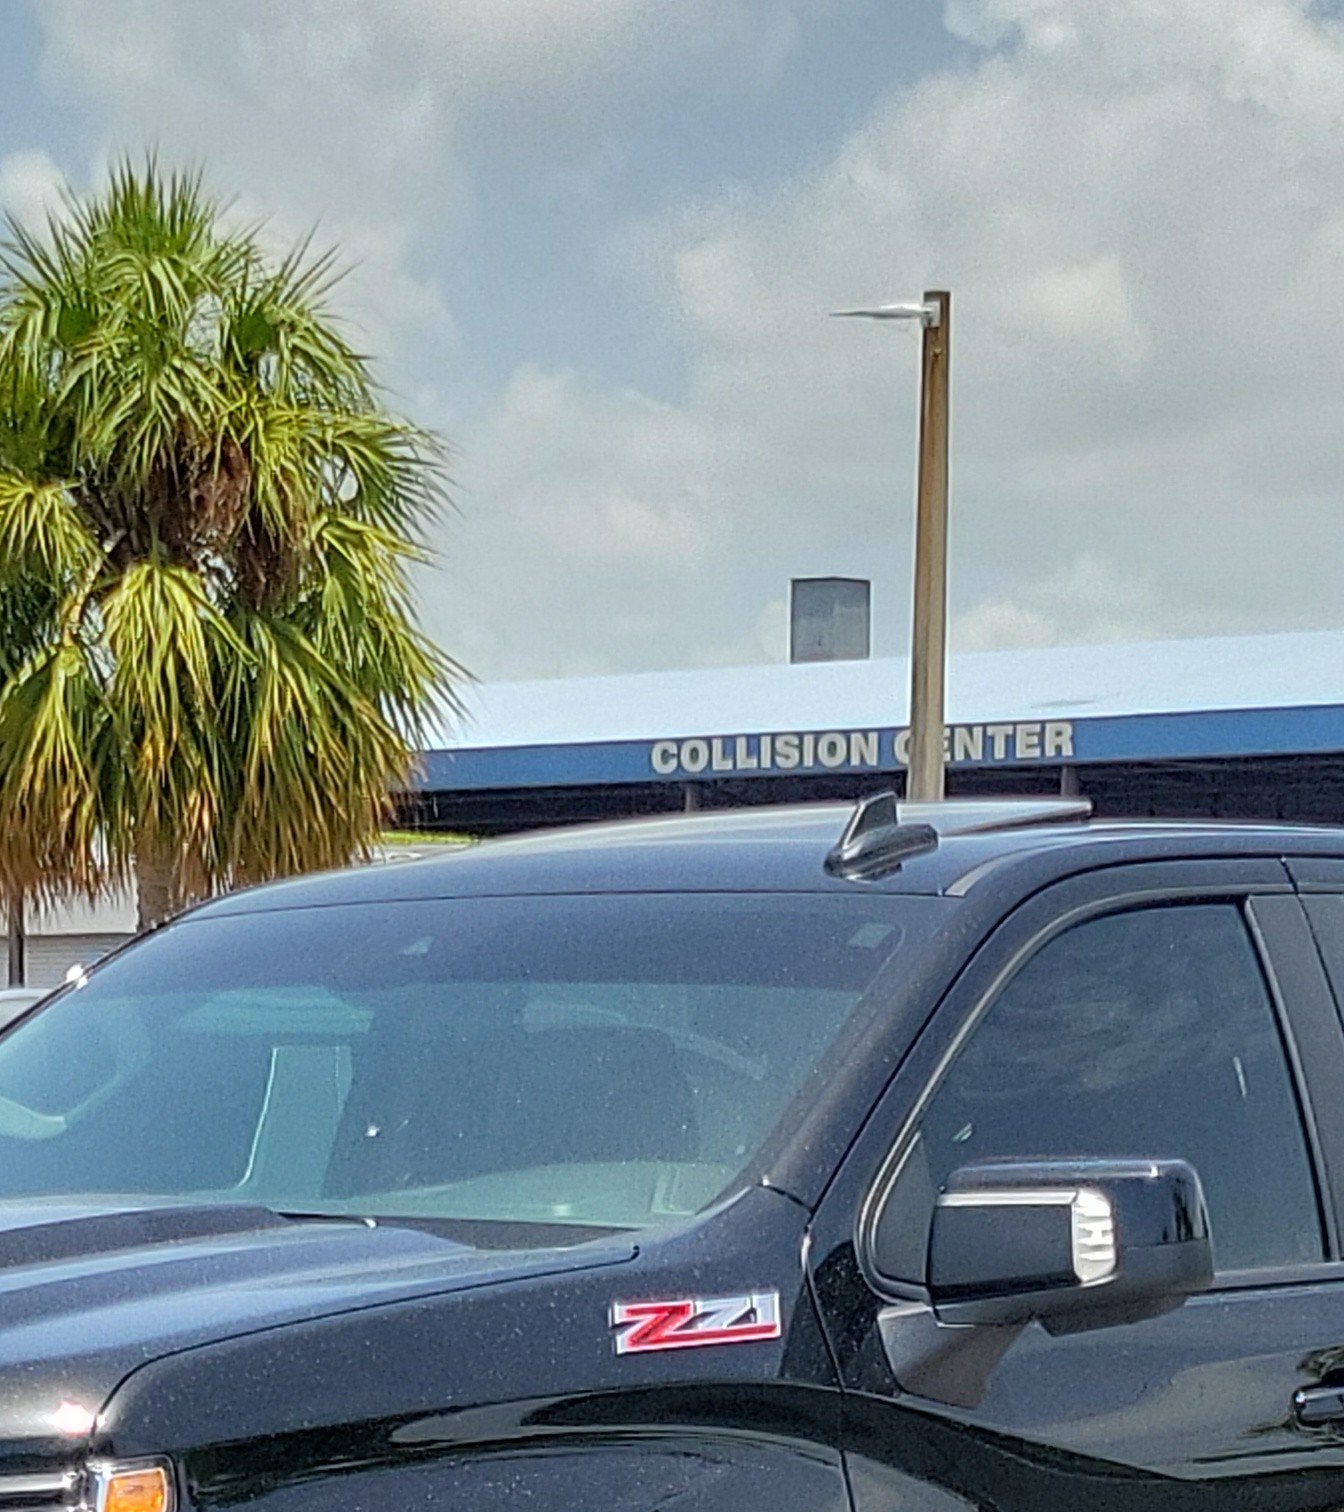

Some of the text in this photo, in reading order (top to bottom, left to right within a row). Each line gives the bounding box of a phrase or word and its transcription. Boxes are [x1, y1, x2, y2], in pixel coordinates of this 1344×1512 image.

[650, 722, 1074, 774] COLLISION CNTER
[610, 1292, 781, 1354] Z71
